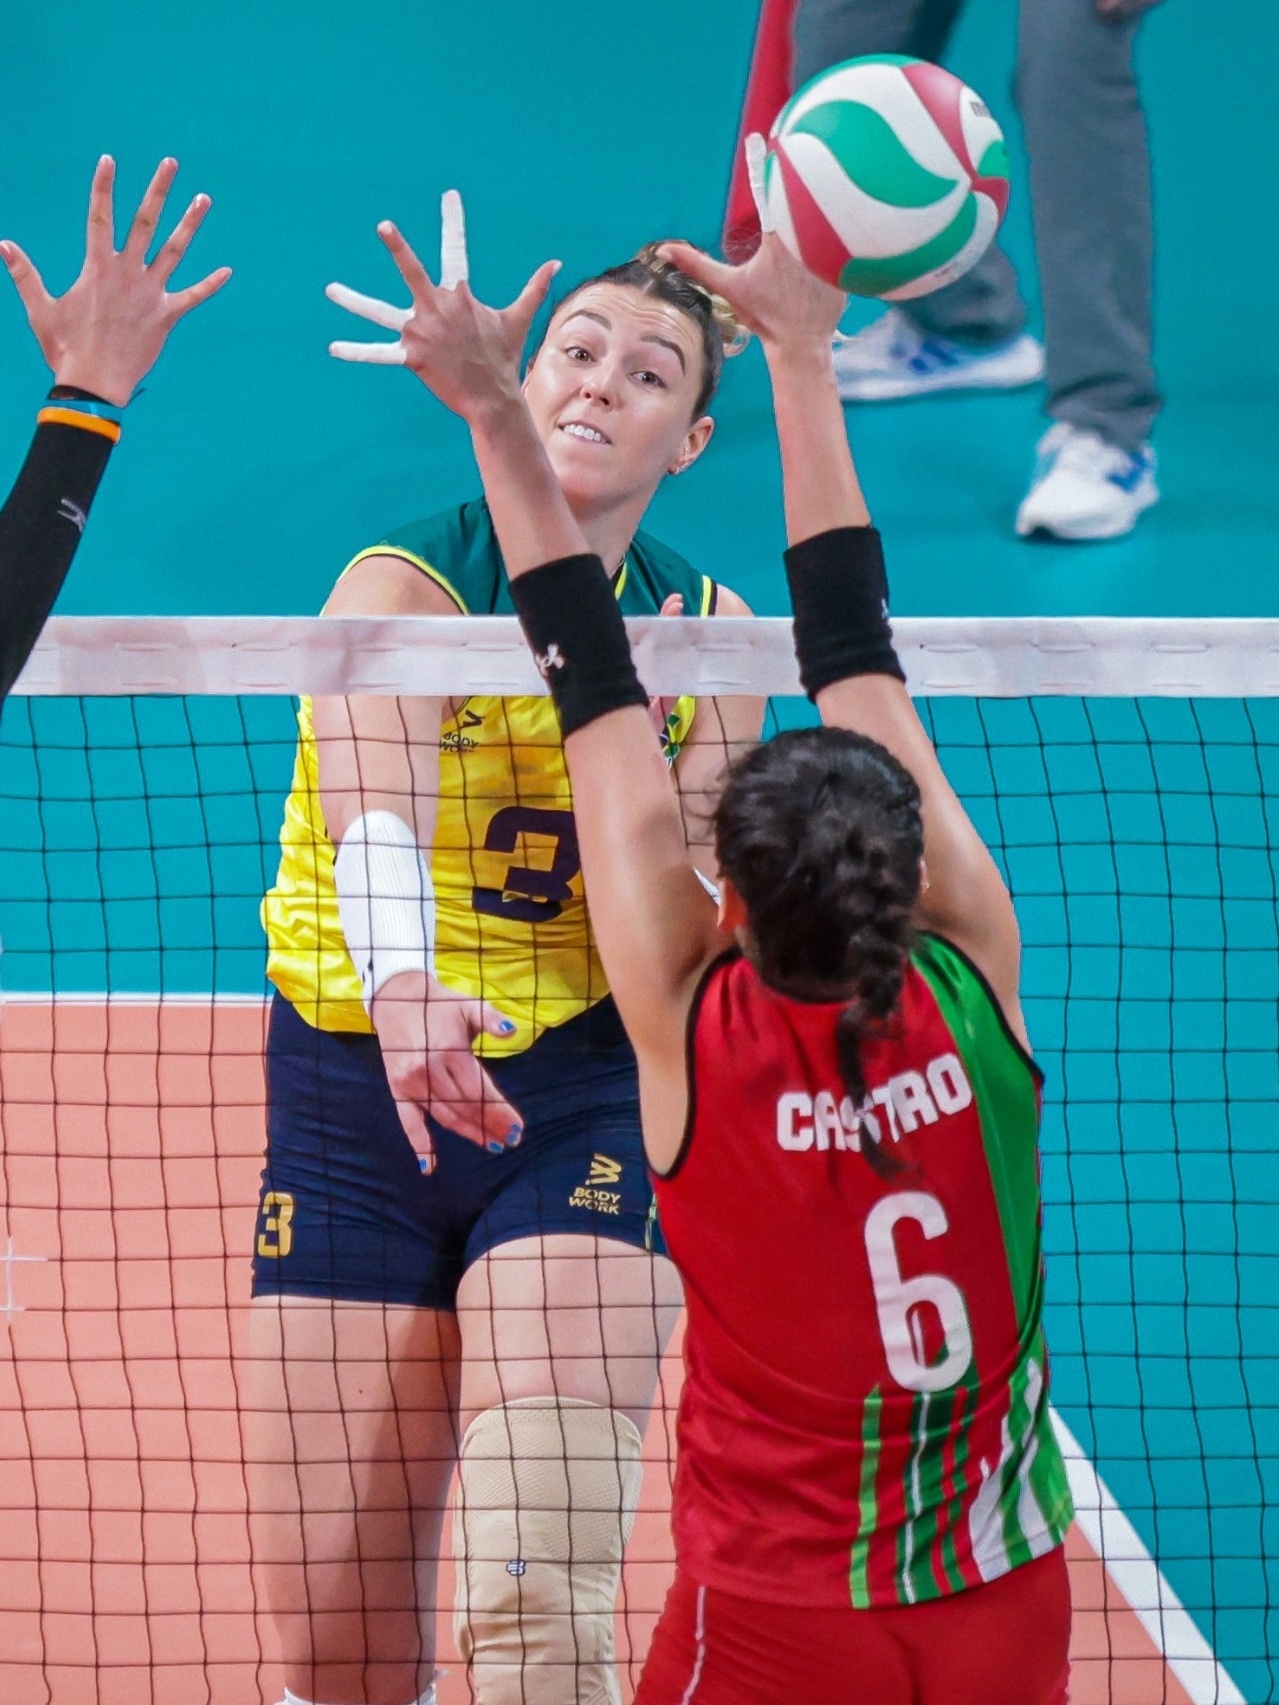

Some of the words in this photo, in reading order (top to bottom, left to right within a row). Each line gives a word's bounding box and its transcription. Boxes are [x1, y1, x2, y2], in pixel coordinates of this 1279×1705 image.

[472, 805, 581, 922] 3
[776, 1052, 973, 1152] CASTRO
[258, 1191, 294, 1258] 3
[569, 1196, 620, 1216] WORK
[574, 1186, 621, 1204] BODY
[864, 1190, 973, 1393] 6
